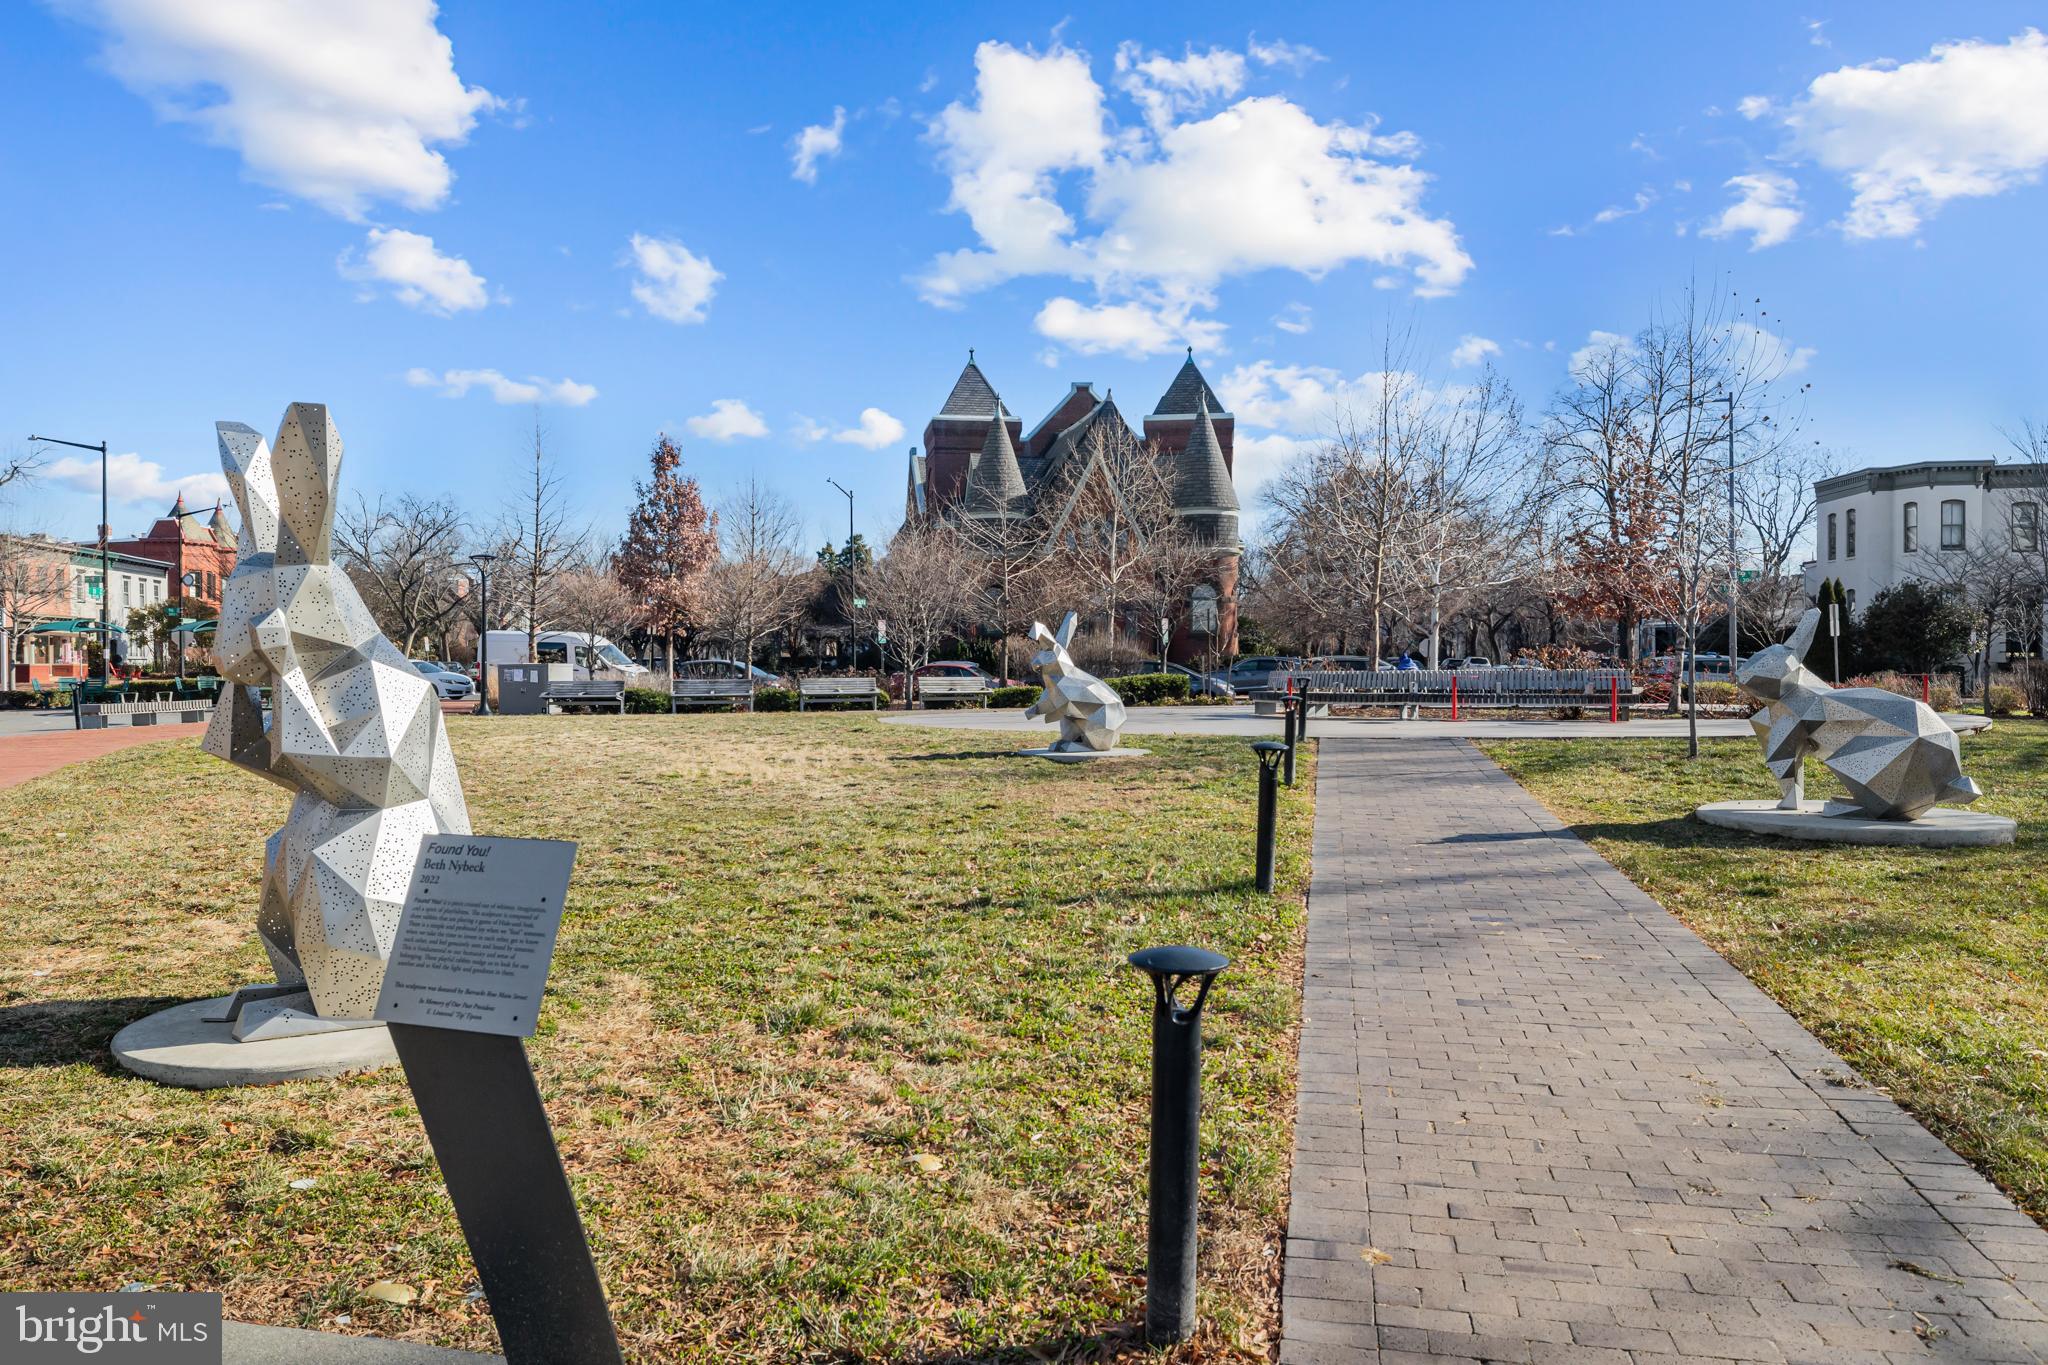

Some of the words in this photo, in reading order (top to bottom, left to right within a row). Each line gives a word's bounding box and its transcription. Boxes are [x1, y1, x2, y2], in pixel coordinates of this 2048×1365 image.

[427, 842, 464, 855] Found
[466, 844, 491, 857] You!
[423, 858, 445, 870] Beth
[448, 859, 485, 874] Nybeck
[419, 874, 440, 884] 2022
